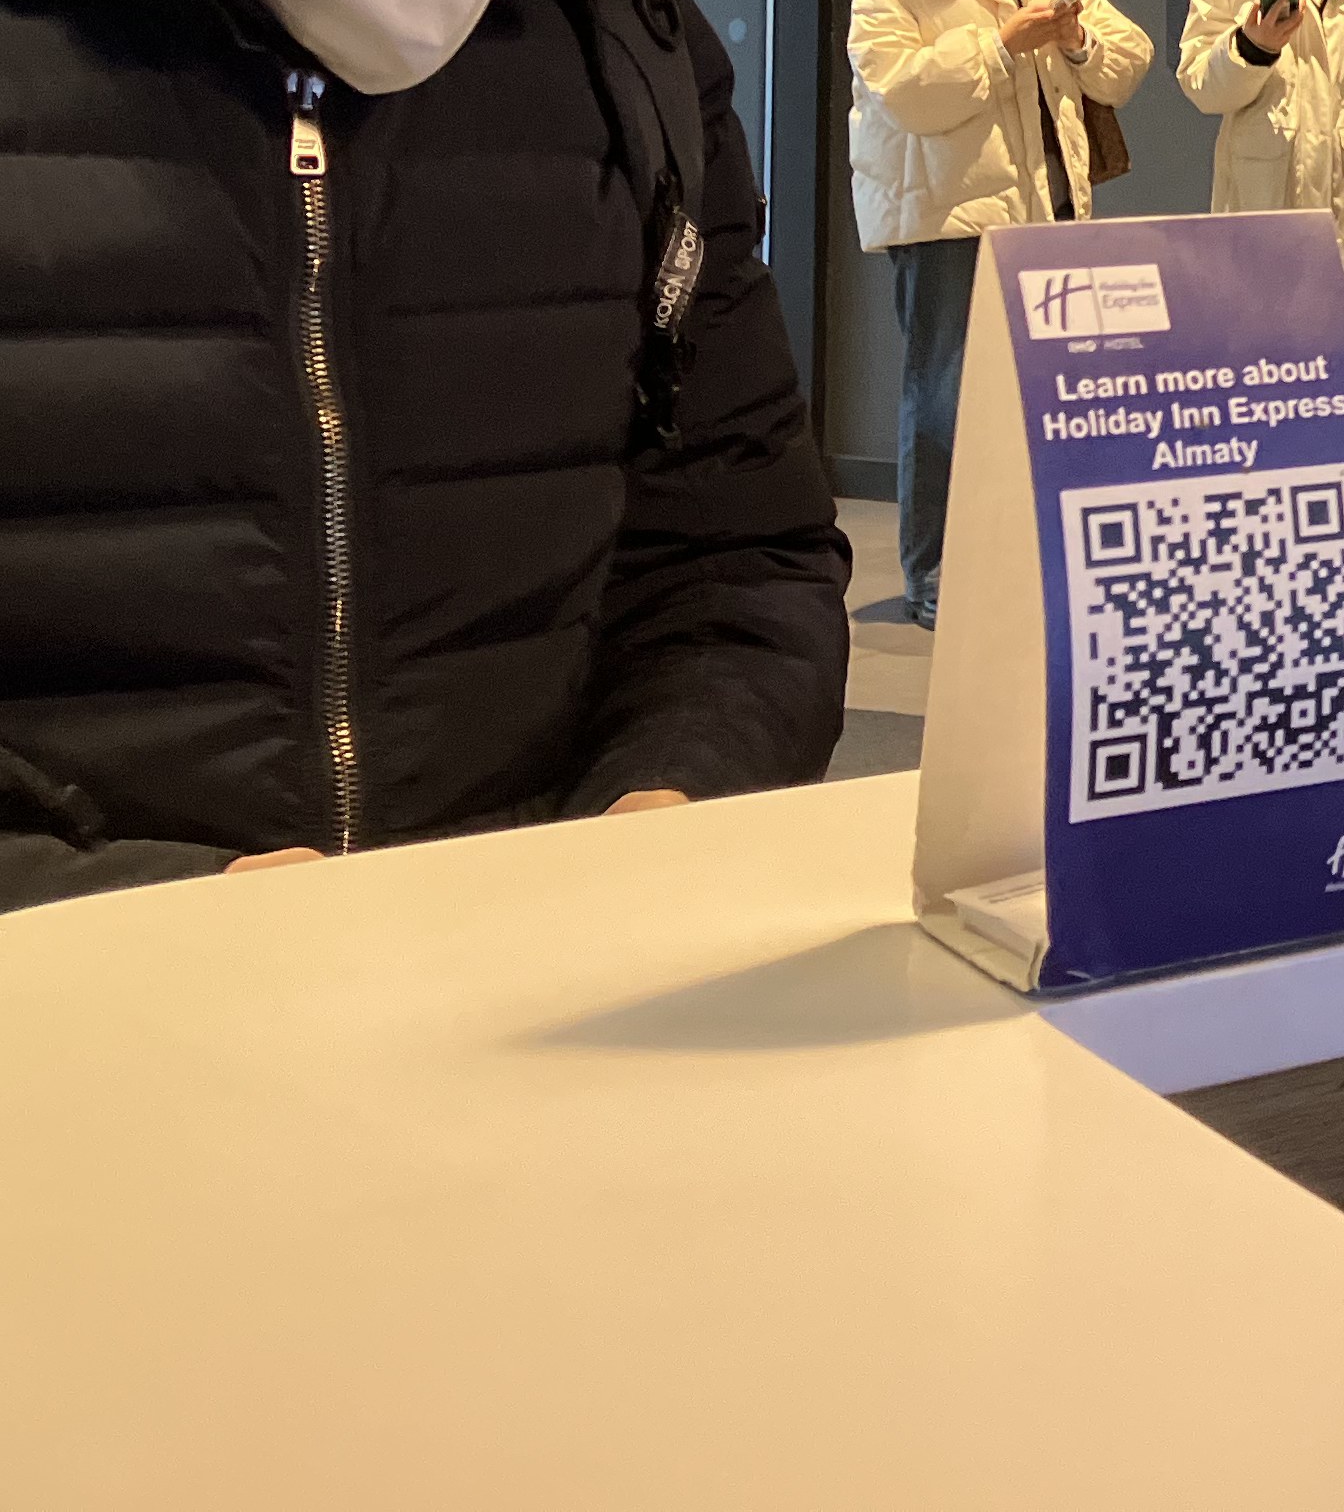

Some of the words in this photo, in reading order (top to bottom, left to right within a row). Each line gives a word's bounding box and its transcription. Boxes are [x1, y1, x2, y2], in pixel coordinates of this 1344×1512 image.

[653, 272, 686, 328] KOLON
[674, 220, 698, 270] SPORT
[1056, 373, 1148, 402] Learn
[1155, 367, 1236, 393] more
[1242, 355, 1330, 386] about
[1042, 408, 1163, 441] Holiday
[1171, 401, 1222, 430] Inn
[1152, 437, 1259, 471] Almaty
